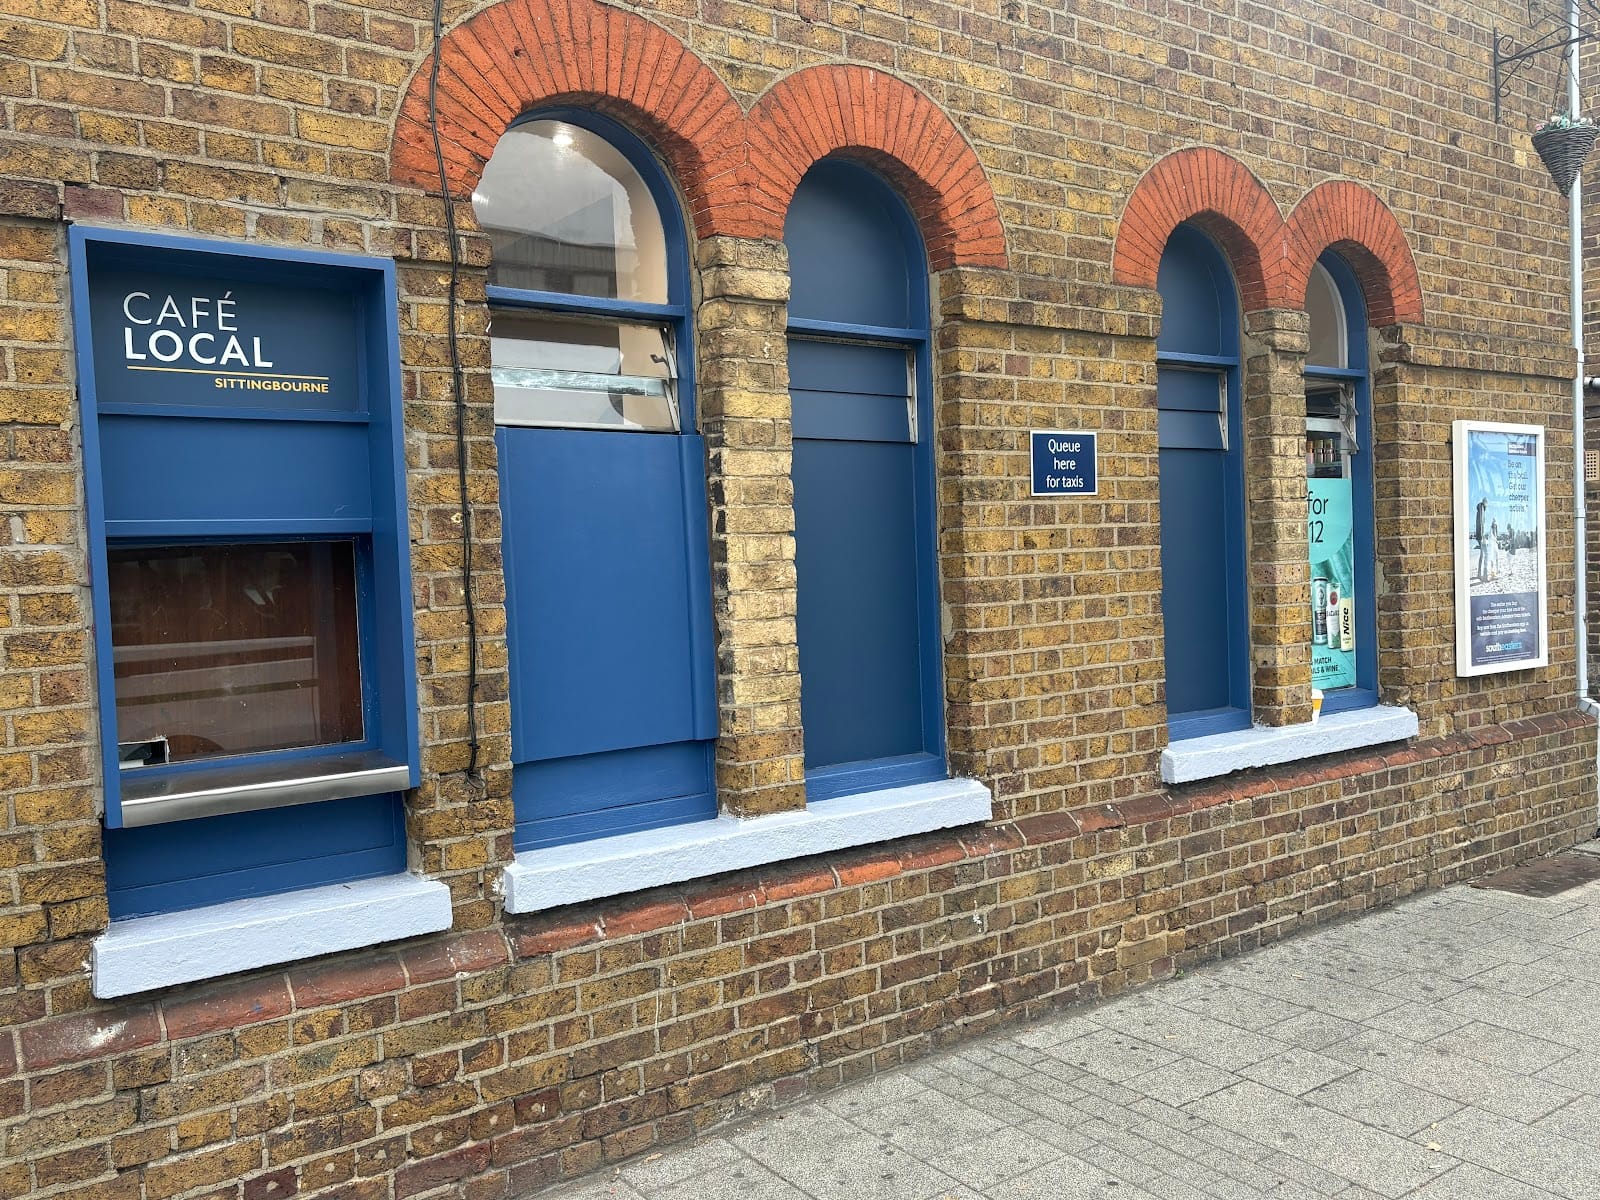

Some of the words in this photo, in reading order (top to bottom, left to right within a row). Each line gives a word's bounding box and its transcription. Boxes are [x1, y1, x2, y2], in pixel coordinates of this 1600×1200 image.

[122, 290, 238, 332] CAFÉ
[124, 326, 273, 368] LOCAL
[214, 378, 329, 394] SITTINGBOURNE
[1048, 438, 1081, 454] Queue
[1053, 457, 1076, 470] here
[1046, 474, 1061, 488] for
[1062, 475, 1084, 488] taxis
[1307, 490, 1328, 515] for
